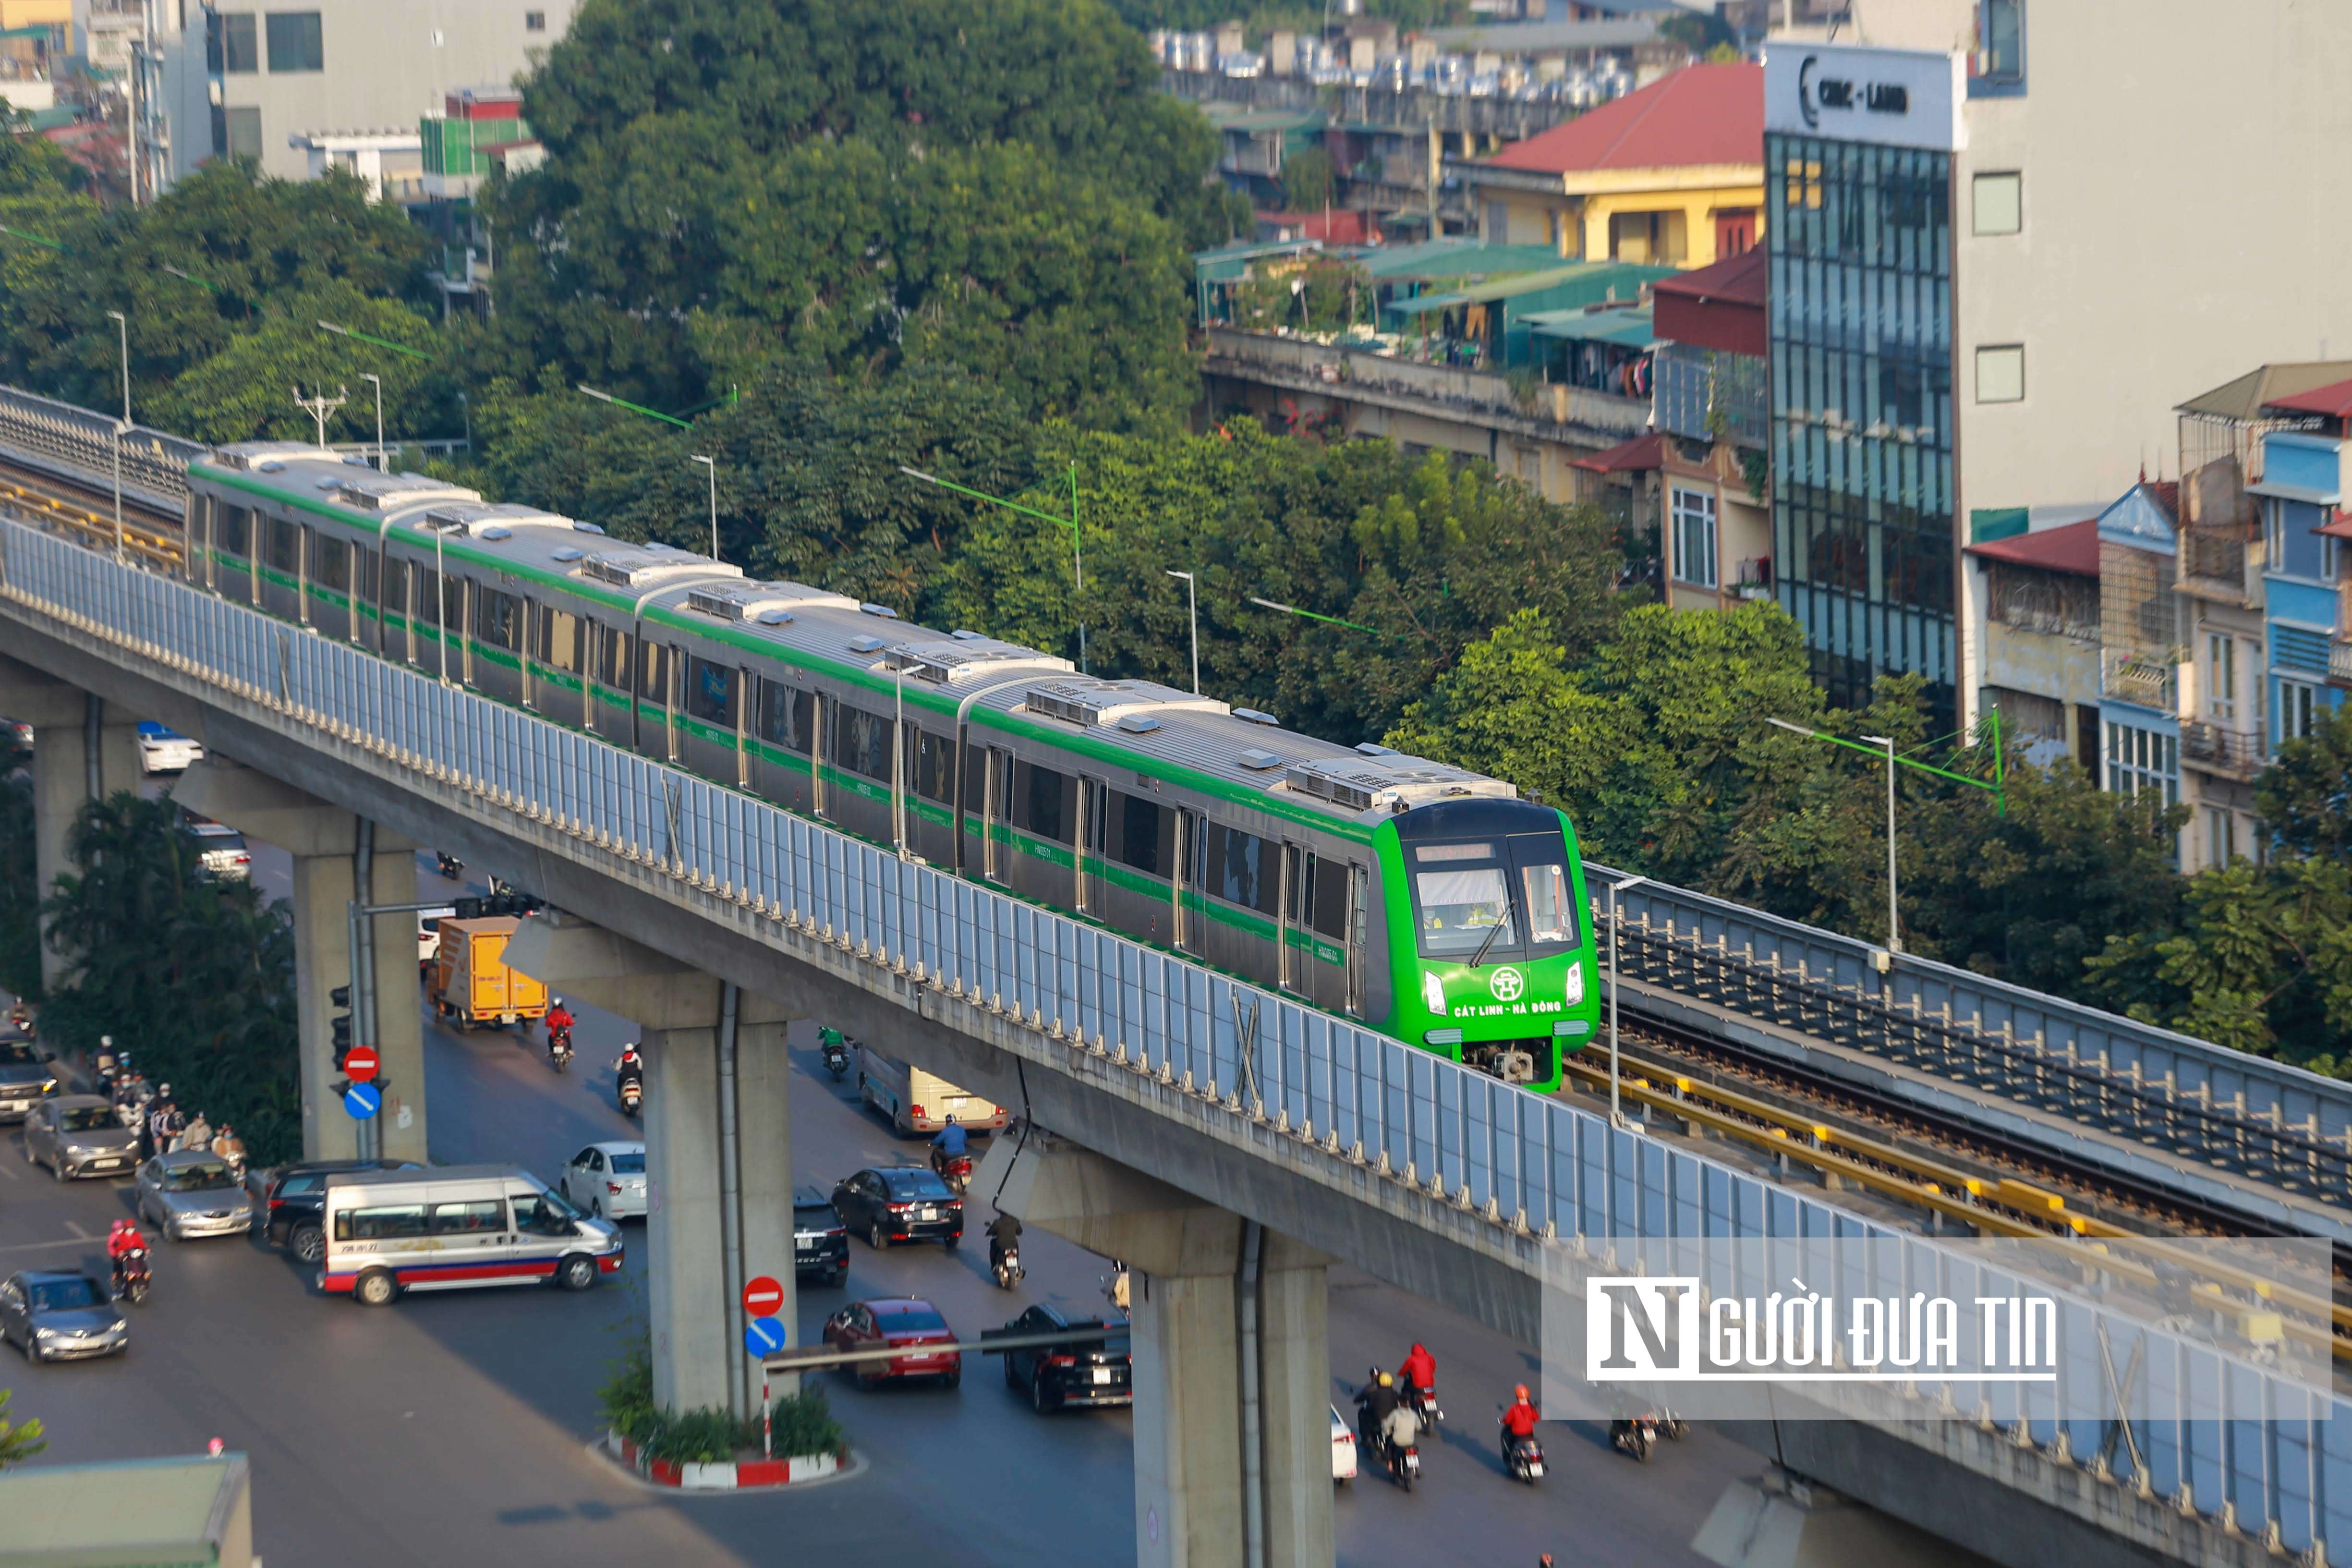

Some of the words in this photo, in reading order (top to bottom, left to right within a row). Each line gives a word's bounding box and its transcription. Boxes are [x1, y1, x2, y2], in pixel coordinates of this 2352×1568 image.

[1454, 1004, 1476, 1018] CÁT
[1479, 1004, 1503, 1016] LINH
[1512, 1001, 1527, 1014] HÀ
[1531, 1000, 1561, 1013] ĐÔNG
